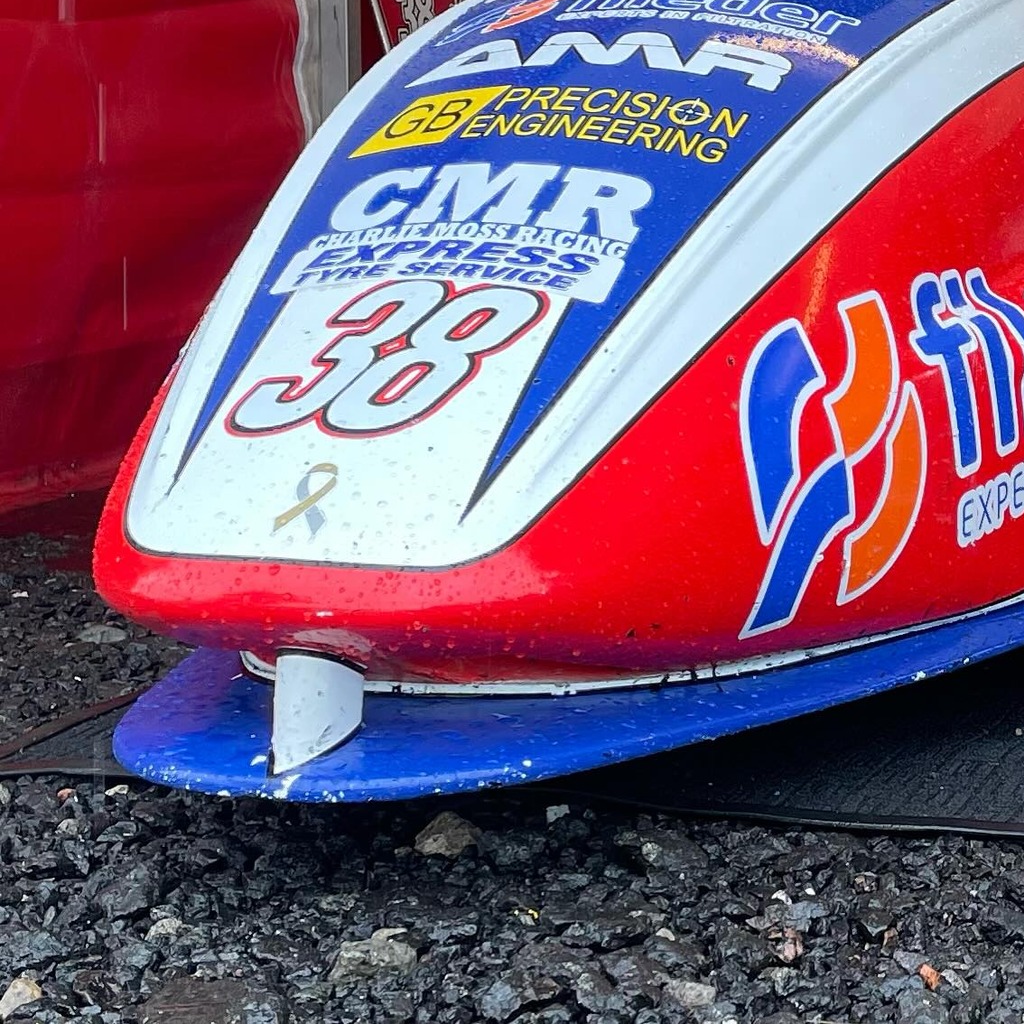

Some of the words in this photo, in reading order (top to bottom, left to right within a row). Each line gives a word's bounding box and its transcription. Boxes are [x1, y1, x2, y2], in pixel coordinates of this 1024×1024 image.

[555, 8, 660, 22] EXPERTS
[658, 10, 691, 21] IN
[692, 11, 828, 44] FILTRATION
[404, 31, 795, 95] AMR
[384, 98, 473, 140] GB
[493, 84, 750, 139] PRECISION
[460, 113, 731, 164] ENGINEERING
[330, 161, 655, 243] CMR
[306, 239, 601, 276] EXPRESS
[309, 223, 425, 251] CHARLIE
[432, 221, 512, 241] MOSS
[519, 226, 631, 260] RACING
[292, 262, 389, 287] TYRE
[396, 261, 582, 291] SERVICE
[223, 279, 551, 439] 38
